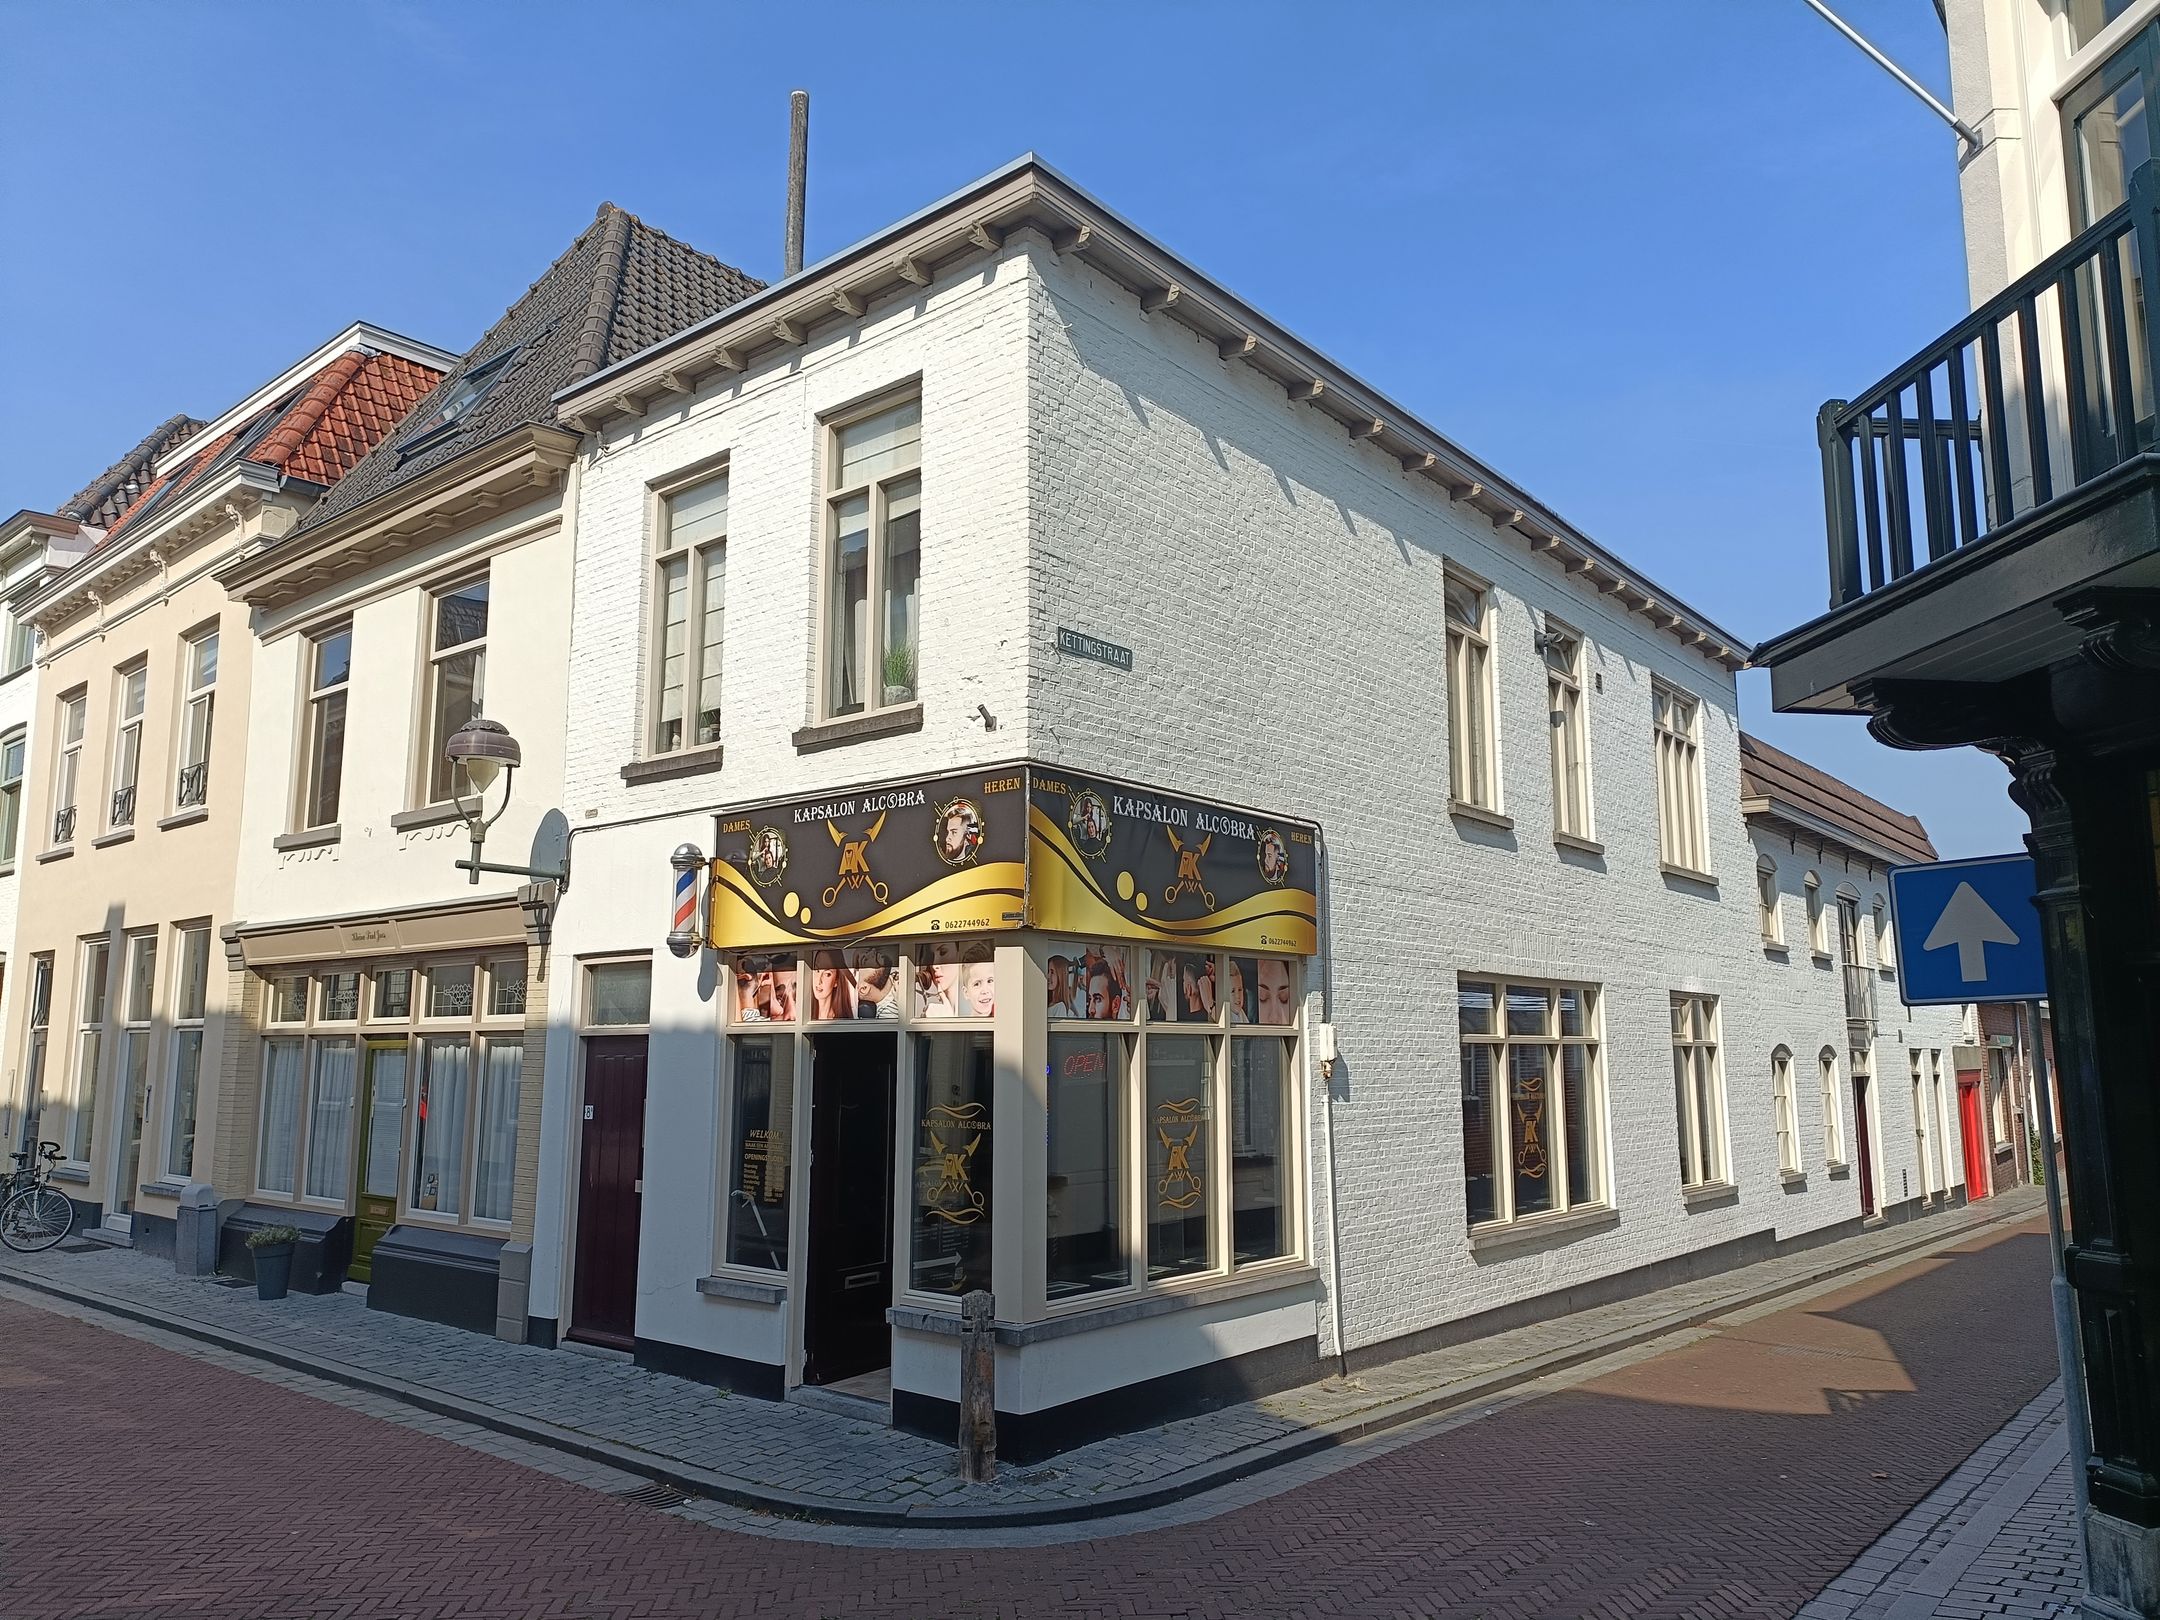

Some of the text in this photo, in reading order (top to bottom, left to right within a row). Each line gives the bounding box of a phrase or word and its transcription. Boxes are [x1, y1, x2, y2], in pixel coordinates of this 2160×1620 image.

[1060, 631, 1130, 665] KETTINGSTRAAT
[984, 777, 1021, 794] HEREN
[1032, 777, 1066, 794] DAMES
[794, 801, 856, 823] KAPSALON
[1113, 796, 1188, 828] KAPSALON
[722, 820, 751, 834] DAMES
[1290, 831, 1312, 845] HEREN
[945, 918, 990, 929] 0622744962
[1064, 1053, 1106, 1077] OPEN
[921, 1119, 956, 1128] KAPSALON
